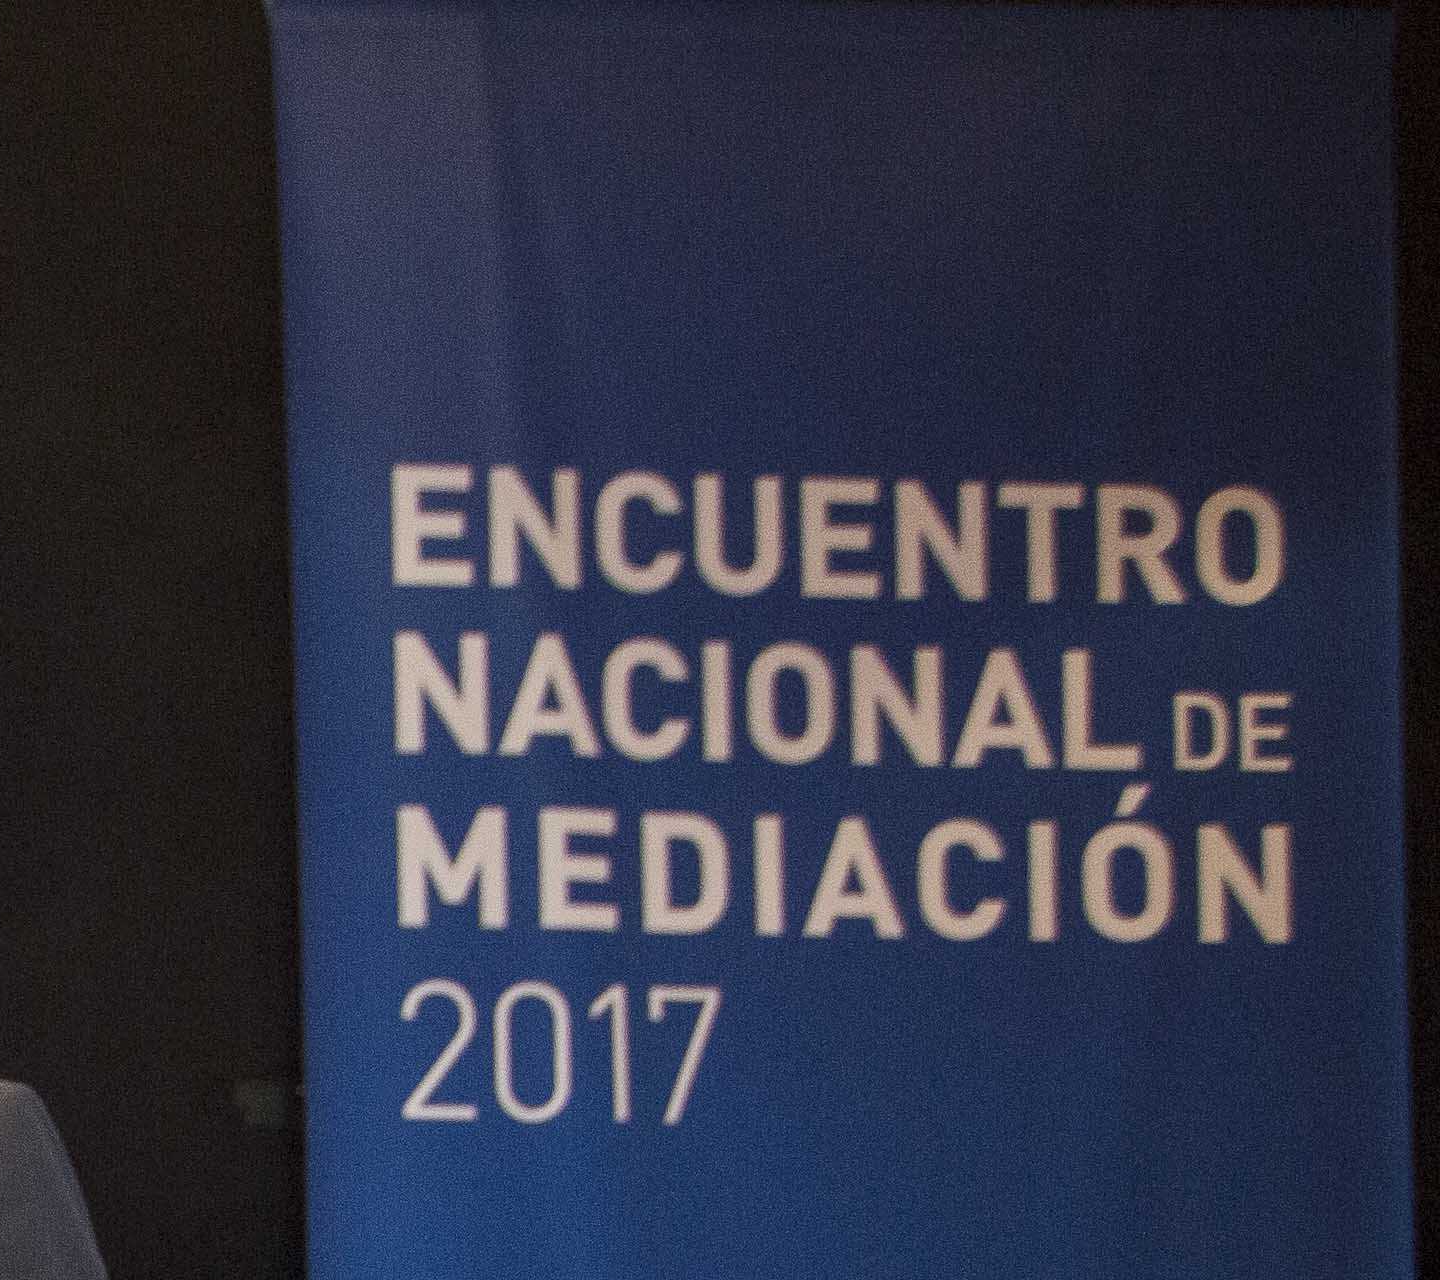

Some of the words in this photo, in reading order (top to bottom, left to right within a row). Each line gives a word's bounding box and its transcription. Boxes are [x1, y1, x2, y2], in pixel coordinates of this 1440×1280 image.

[391, 463, 1286, 607] ENCUENTRO
[391, 630, 1142, 771] NACIONAL
[1173, 693, 1293, 773] DE
[394, 784, 1293, 944] MEDIACIÓN
[400, 978, 723, 1126] 2017
